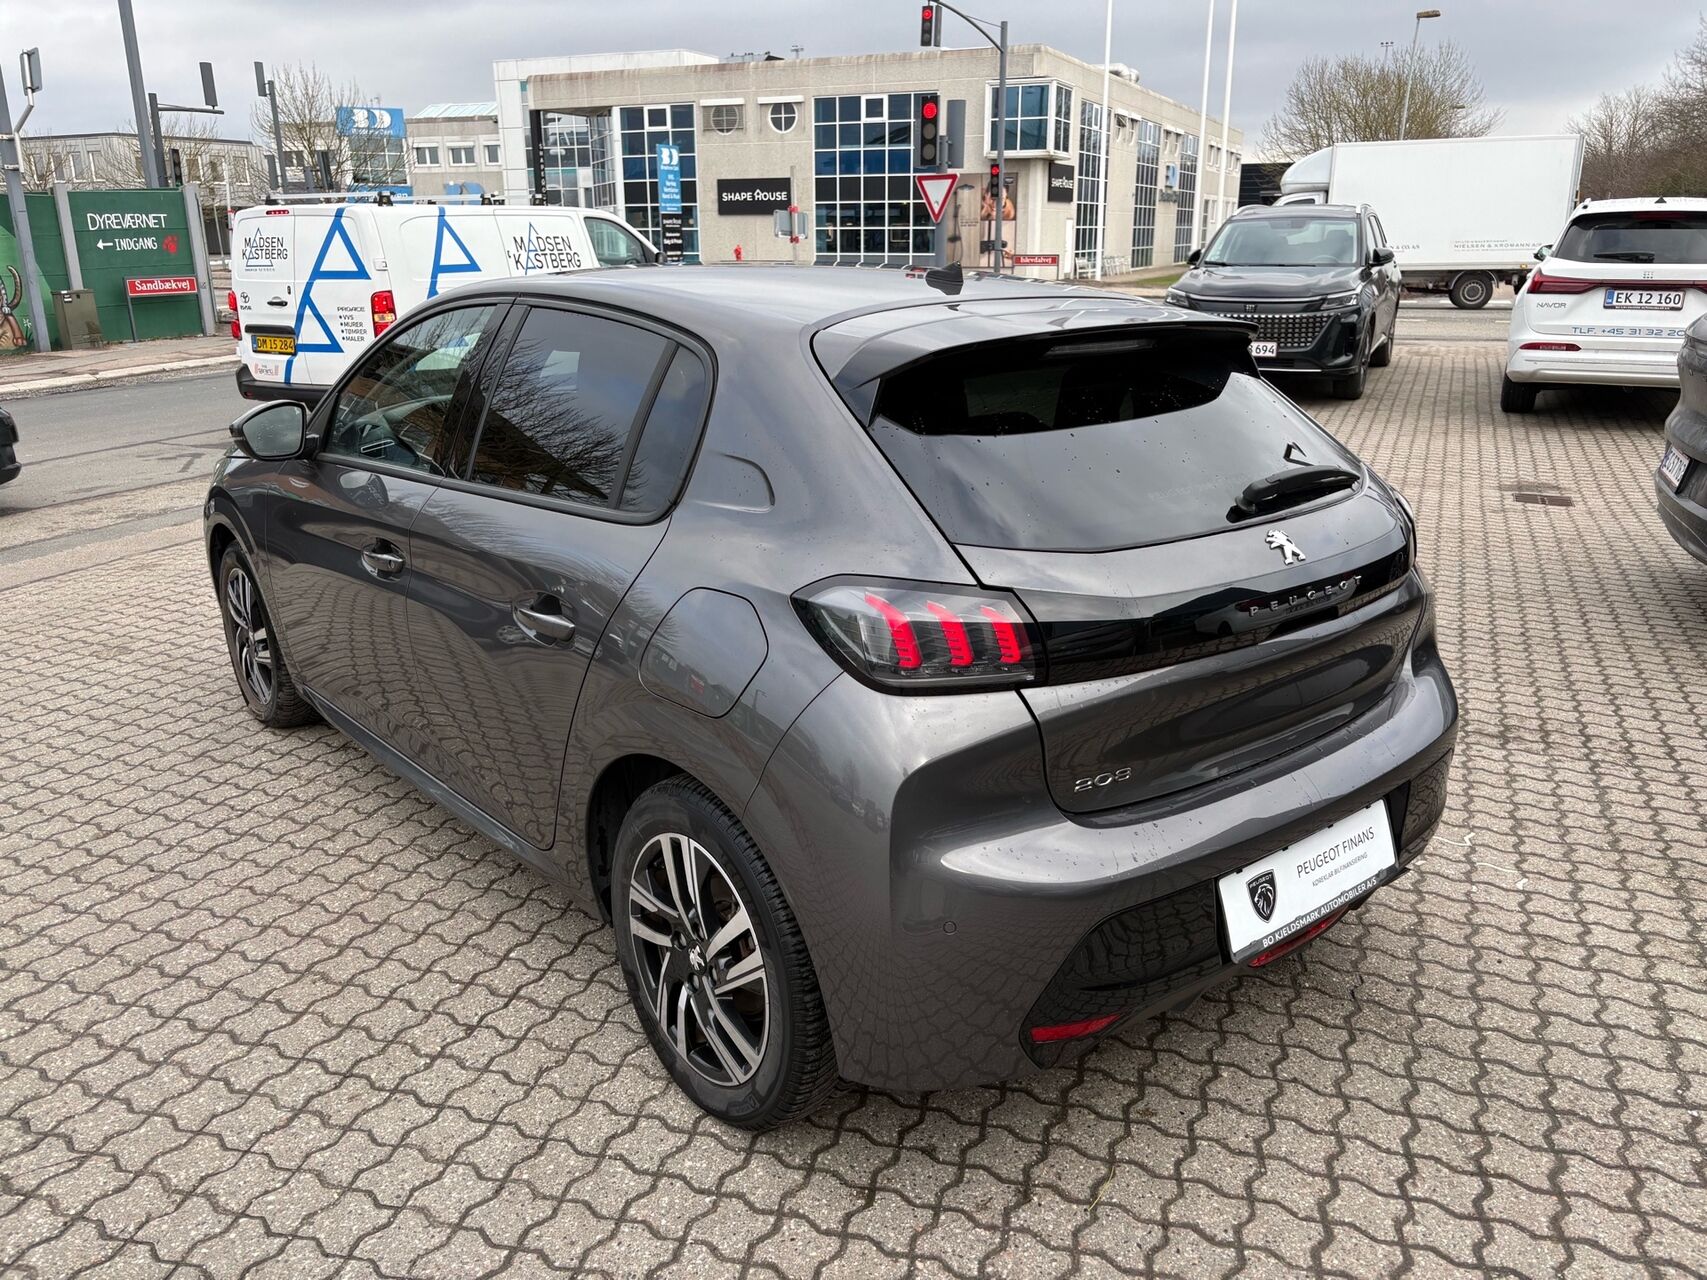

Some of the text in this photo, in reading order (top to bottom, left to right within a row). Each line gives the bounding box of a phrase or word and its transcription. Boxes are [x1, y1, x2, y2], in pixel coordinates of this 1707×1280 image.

[722, 188, 788, 201] SHAPE HOUSE
[87, 213, 167, 230] DYREVÆRNET
[114, 237, 158, 251] INDGANG
[244, 236, 284, 248] MADSEN
[513, 236, 573, 252] MADSEN
[242, 248, 288, 260] KASTBERG
[513, 252, 582, 270] KASTBERG
[135, 279, 191, 291] Sandbækvej
[1615, 292, 1681, 305] EK 12 160
[1572, 326, 1597, 334] TLF.
[257, 338, 294, 351] DM 15 284
[1255, 344, 1275, 355] 694
[1250, 575, 1362, 617] PEUGEOT
[1073, 767, 1132, 793] 208
[1296, 826, 1375, 878] PEUGEOT FINANS
[1249, 874, 1272, 889] PEUGEOT
[1262, 876, 1377, 948] BO KJELDSMARK AUTOMOBILER A/S
